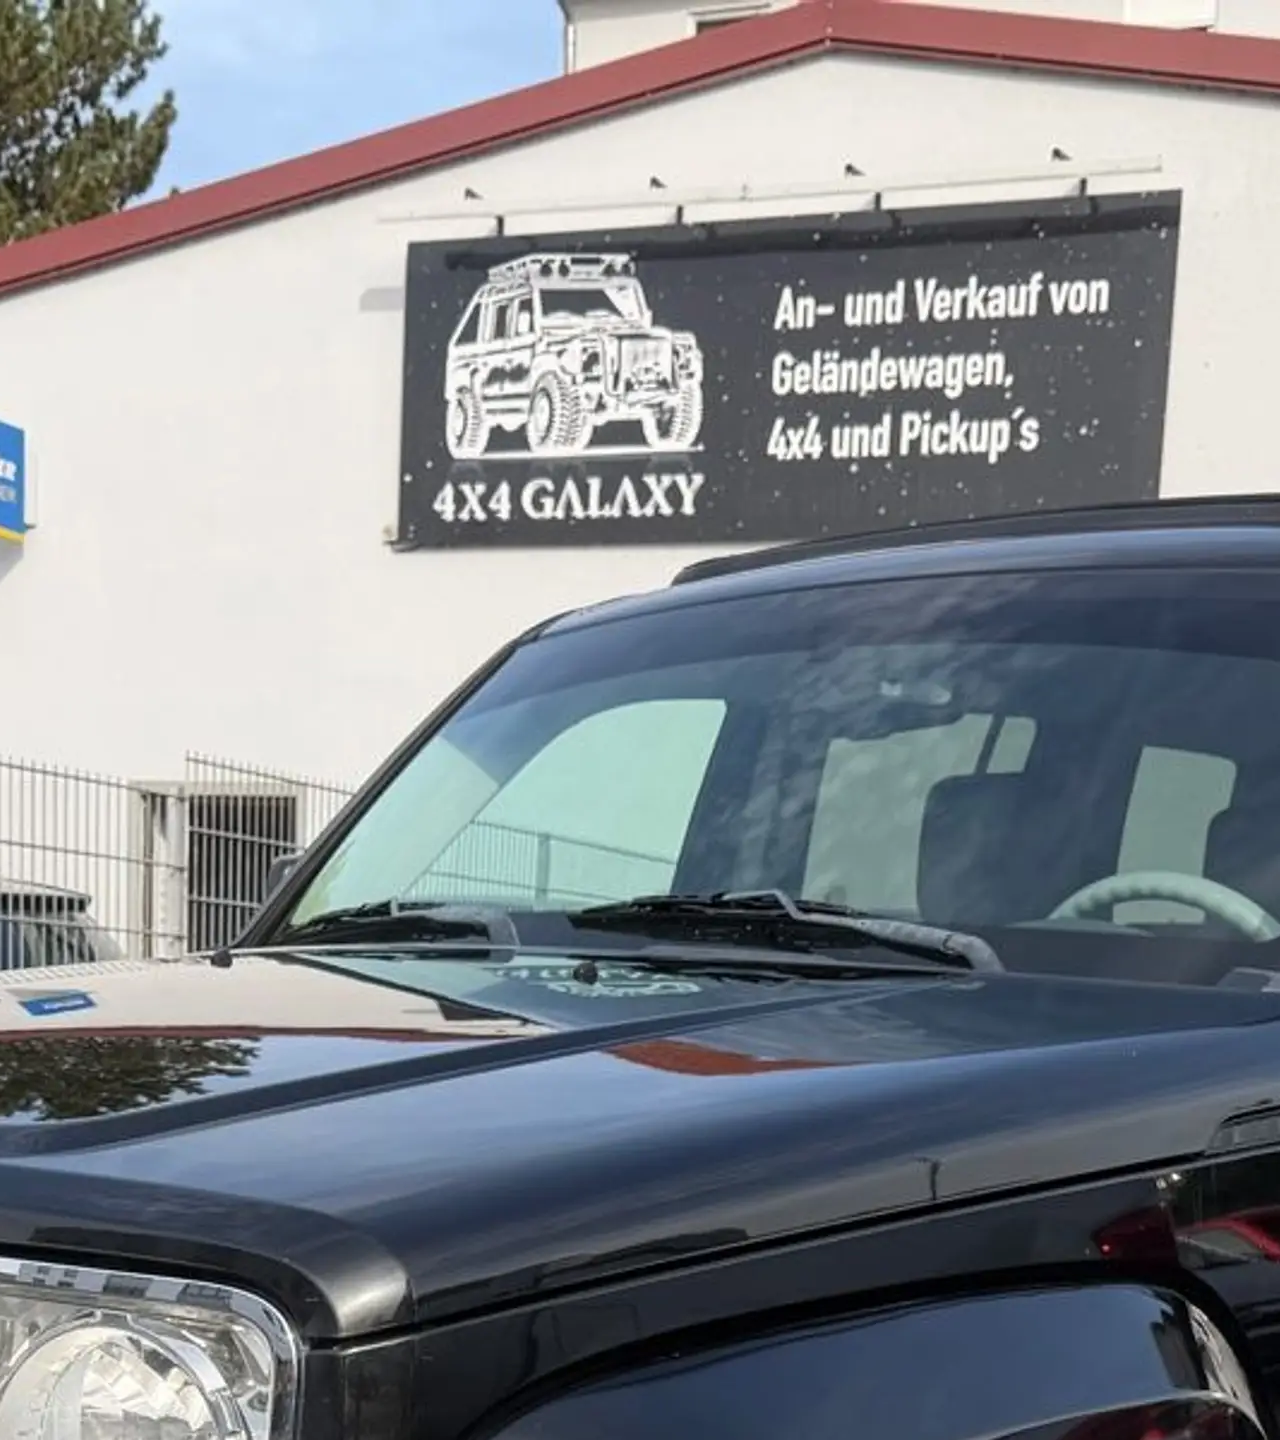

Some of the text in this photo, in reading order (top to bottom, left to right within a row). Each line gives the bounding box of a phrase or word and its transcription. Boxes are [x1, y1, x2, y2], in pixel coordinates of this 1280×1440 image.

[773, 275, 1110, 331] An- und Verkauf von
[771, 349, 1015, 400] Geländewagen,
[766, 418, 823, 460] 4x4
[831, 417, 891, 458] und
[432, 472, 705, 522] 4X4 GALAXY
